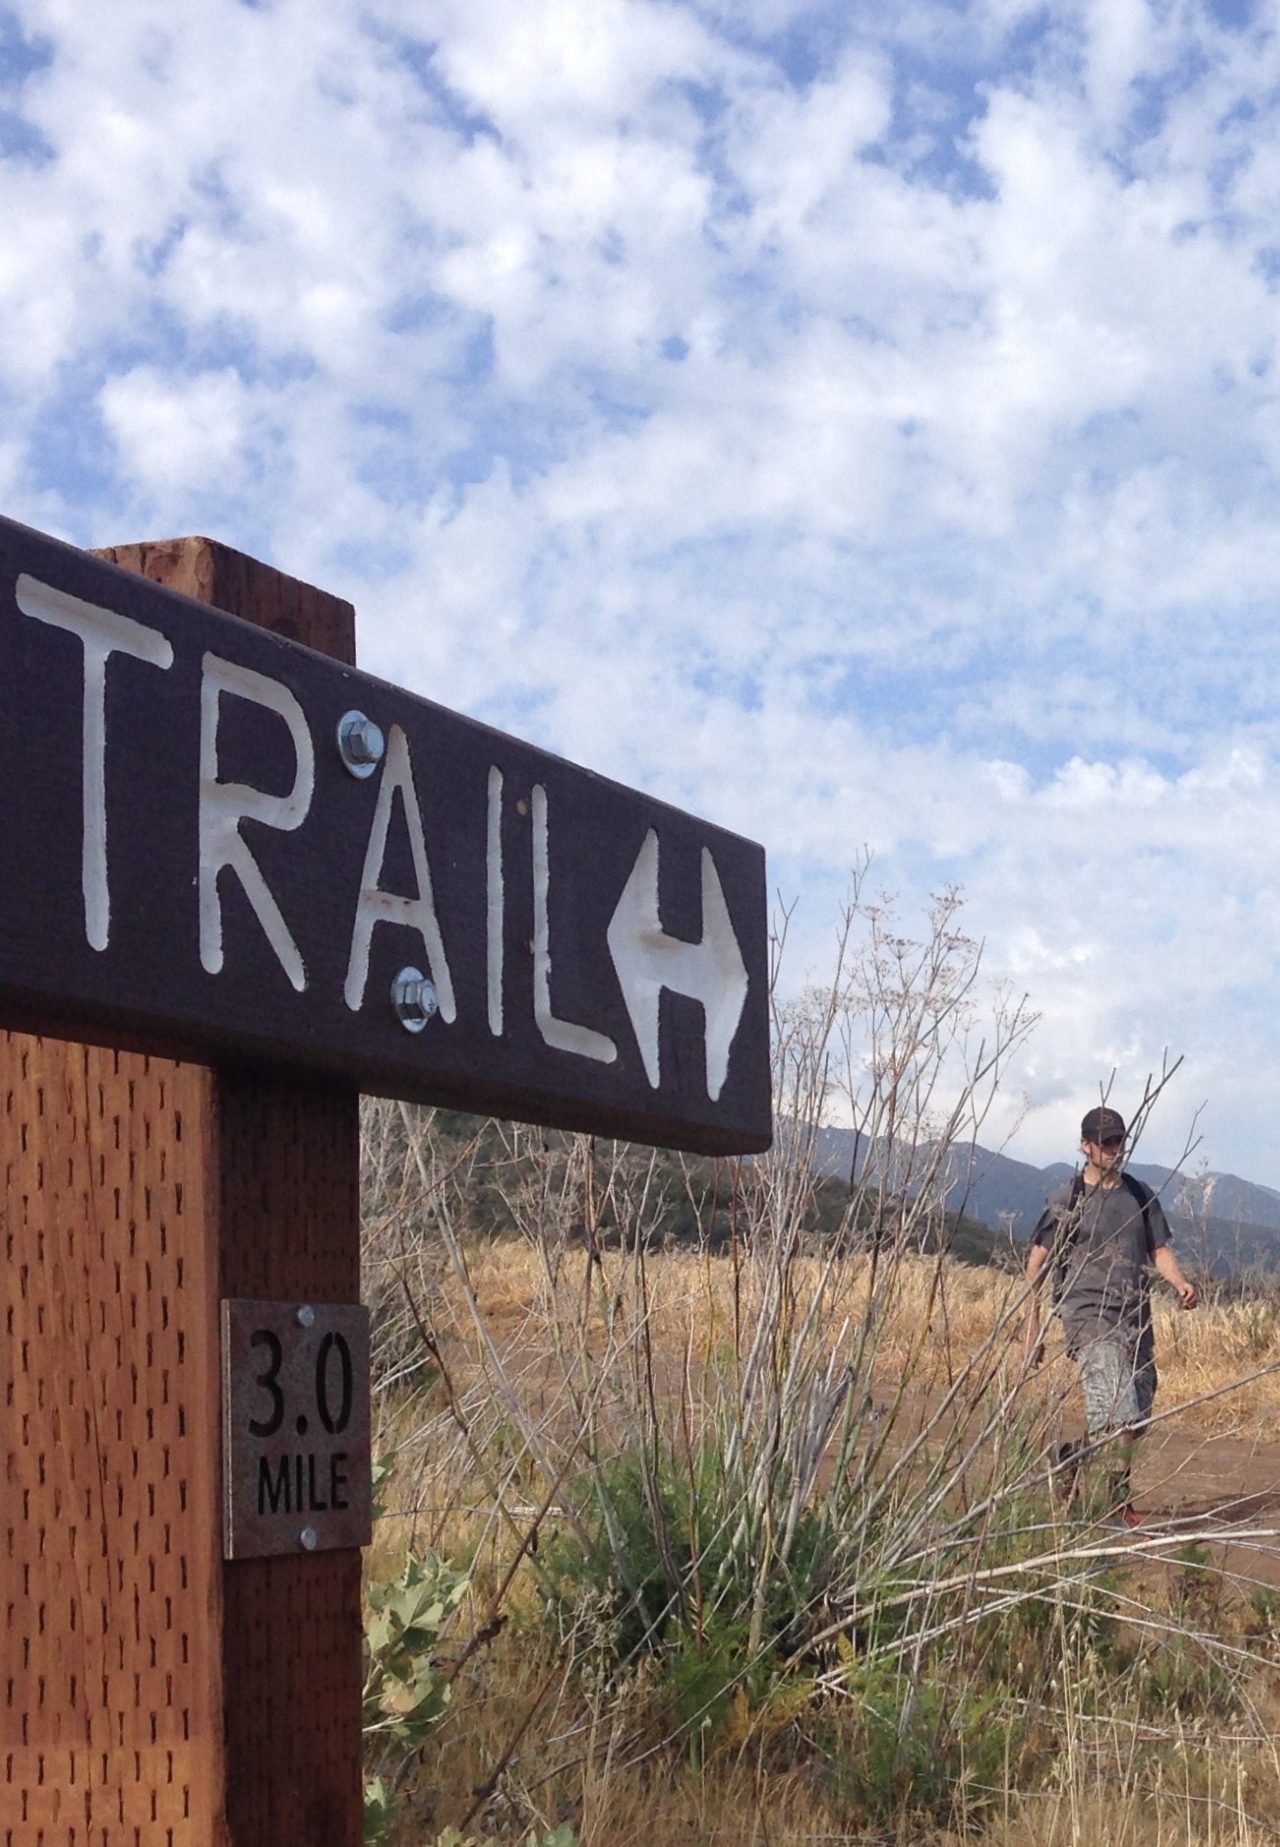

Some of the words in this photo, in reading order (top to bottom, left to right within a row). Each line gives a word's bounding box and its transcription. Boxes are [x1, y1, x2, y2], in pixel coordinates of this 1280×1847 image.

[15, 573, 618, 1064] TRAIL
[248, 1329, 353, 1438] 3.0
[257, 1452, 349, 1515] MILE
